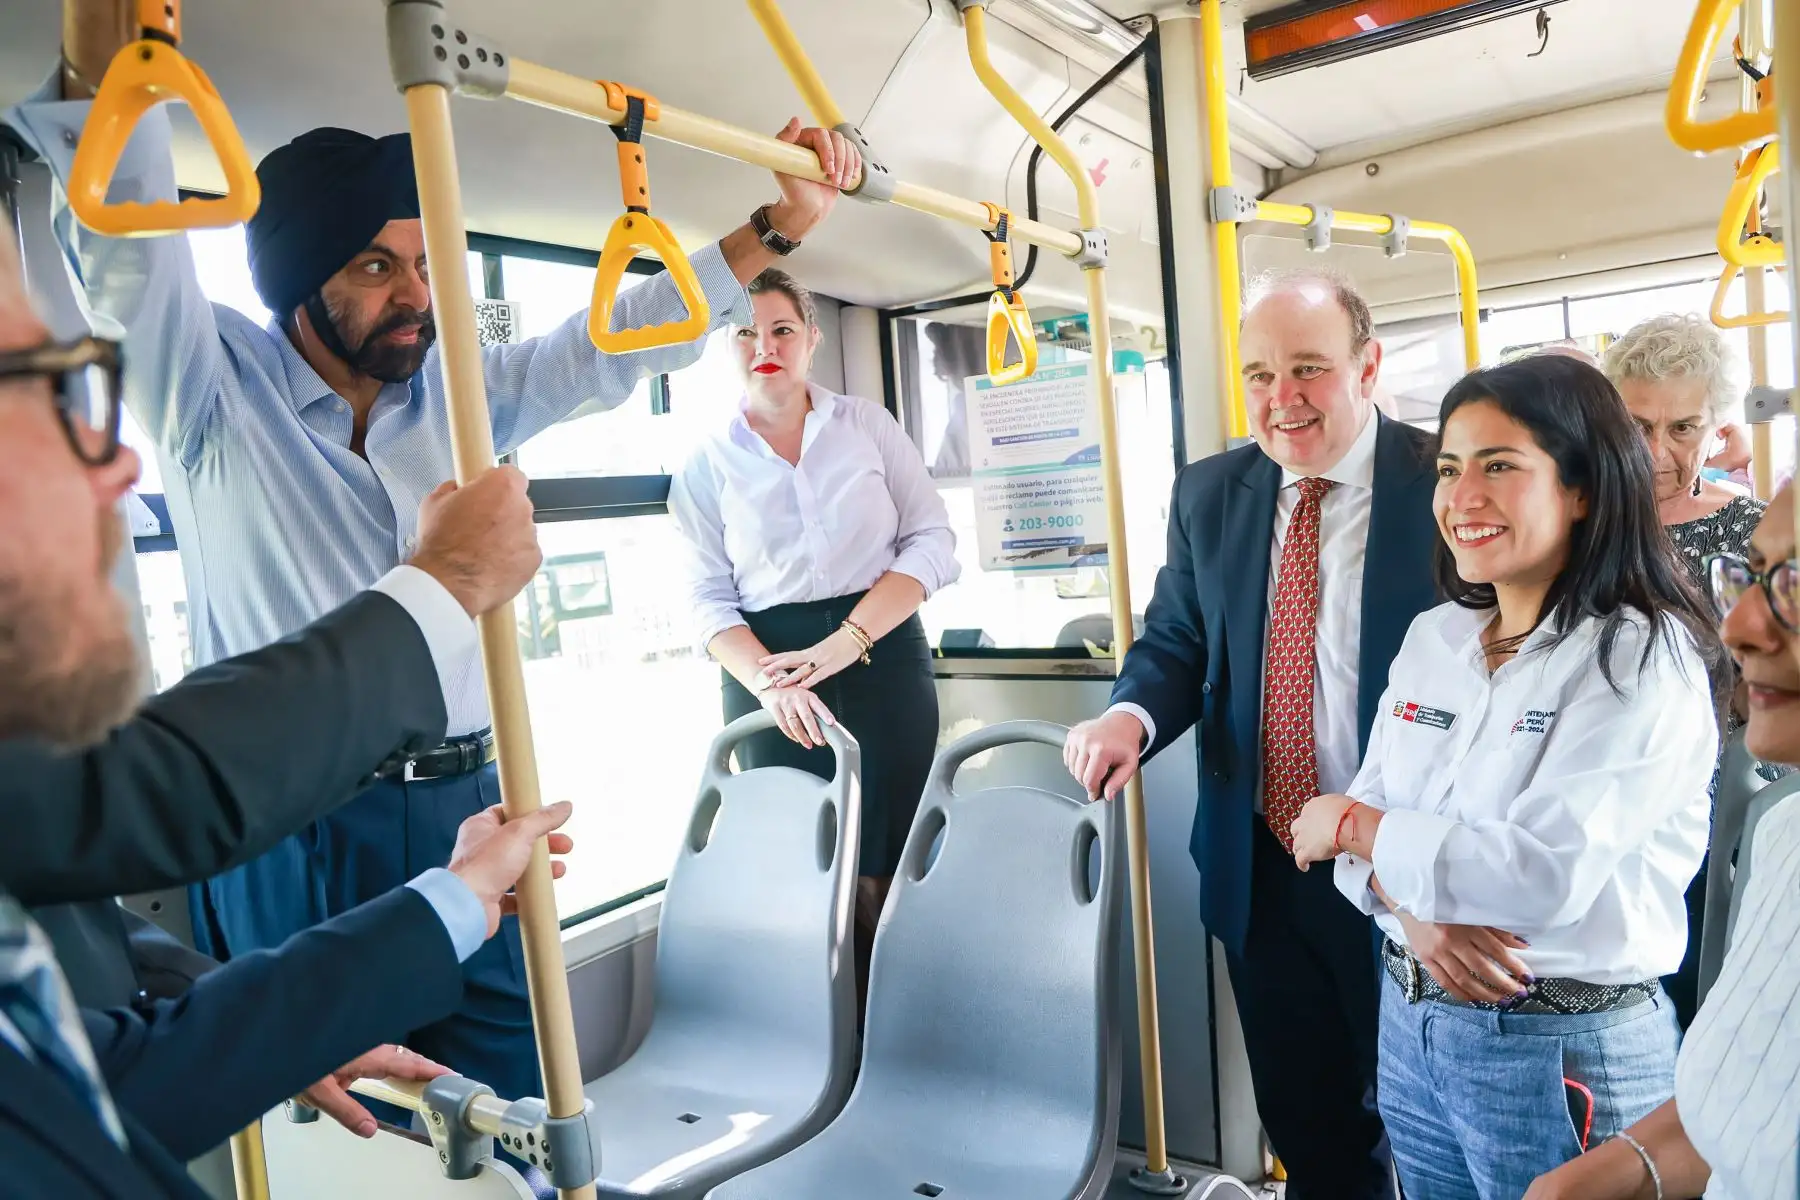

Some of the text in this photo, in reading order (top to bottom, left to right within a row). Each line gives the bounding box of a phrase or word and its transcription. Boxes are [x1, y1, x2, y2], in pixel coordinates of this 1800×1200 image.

[1016, 479, 1045, 489] usuario,
[1046, 478, 1062, 487] para
[1063, 474, 1098, 486] cualquier
[1005, 491, 1034, 500] reclamo
[1034, 488, 1056, 499] puede
[1057, 485, 1103, 495] comunicarse
[1019, 514, 1083, 530] 203-9000
